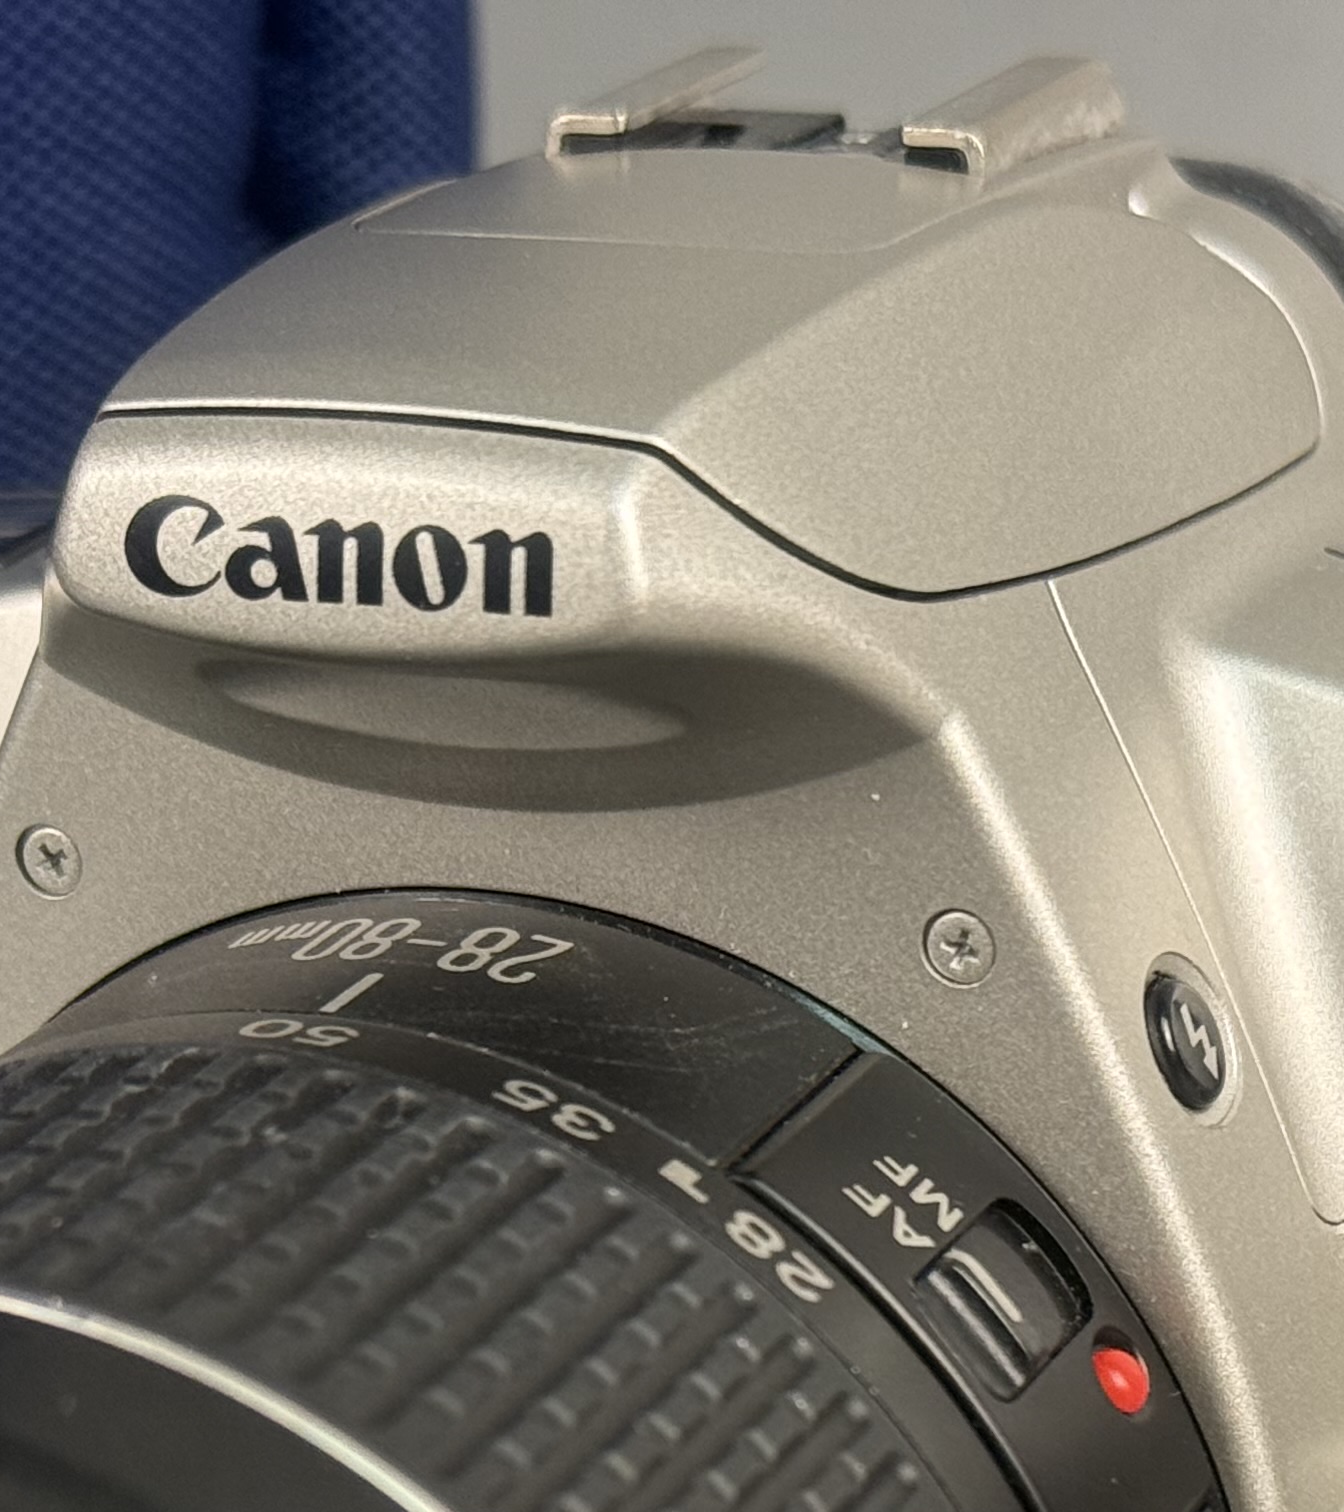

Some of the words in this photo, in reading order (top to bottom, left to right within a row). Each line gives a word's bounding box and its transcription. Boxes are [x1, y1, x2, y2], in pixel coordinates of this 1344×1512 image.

[124, 494, 554, 618] Canon
[227, 916, 575, 985] 28-80mm
[238, 1018, 360, 1047] 50
[491, 1078, 617, 1141] 35
[840, 1182, 937, 1249] AF
[871, 1155, 965, 1233] MF
[724, 1209, 837, 1303] 28
